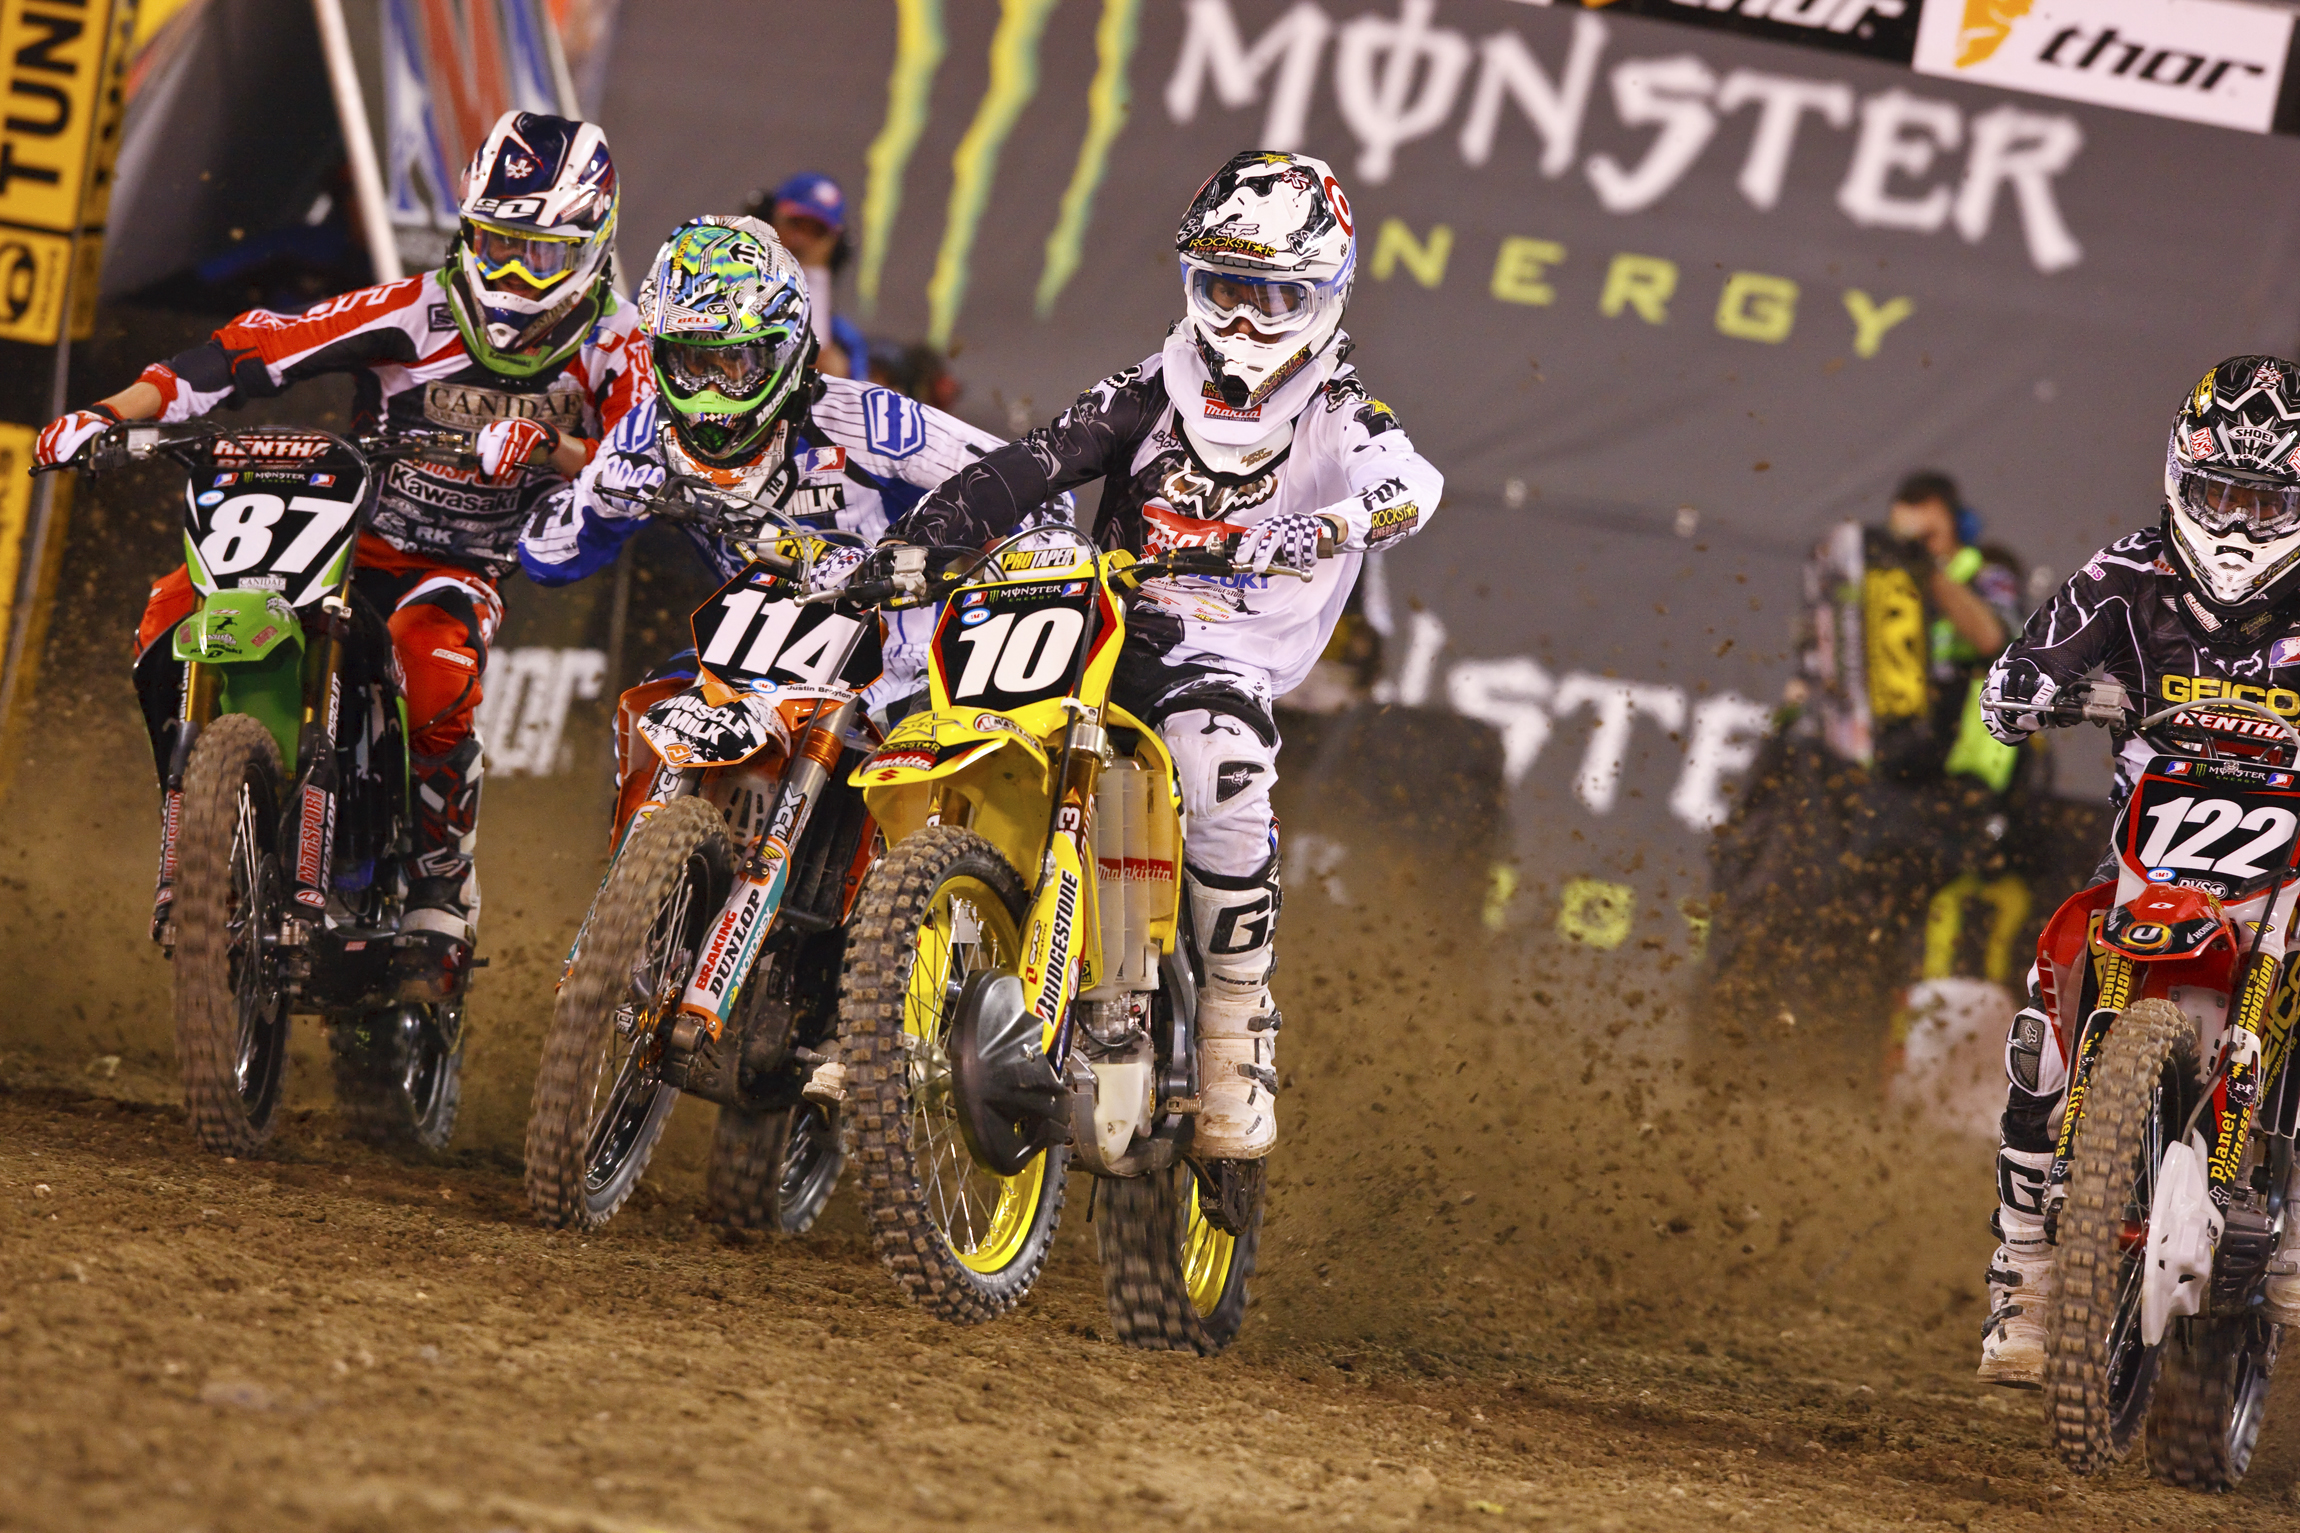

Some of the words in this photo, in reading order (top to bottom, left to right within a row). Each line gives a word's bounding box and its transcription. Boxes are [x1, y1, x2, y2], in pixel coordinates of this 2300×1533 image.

[2036, 24, 2267, 95] thor
[0, 0, 87, 196] TUN
[1193, 245, 1231, 253] ENERGY
[1236, 248, 1267, 260] DRINK
[1370, 217, 1914, 360] NERGY
[677, 316, 712, 324] BELL
[430, 387, 582, 420] CANIDAE
[213, 438, 332, 459] RENTHA
[2235, 429, 2274, 443] SHOEI
[255, 470, 307, 482] MONSTER
[389, 462, 521, 514] Kawasaki
[766, 477, 785, 497] 114
[1362, 477, 1409, 512] FOX
[198, 492, 354, 576] 87
[415, 525, 453, 545] RK
[1371, 523, 1399, 539] ENERGY
[239, 577, 286, 588] CANIDAE
[1001, 584, 1062, 598] MONSTER
[1008, 595, 1052, 603] ENERGY
[701, 588, 852, 692] 114
[954, 607, 1086, 700] 10
[786, 683, 816, 693] Justin
[817, 686, 853, 700] Brayton
[2160, 673, 2300, 717] GEICO
[660, 694, 750, 740] MUSCLE
[661, 708, 727, 746] MILK
[2172, 710, 2298, 741] RENTHA
[2215, 774, 2257, 785] ENERGY
[2138, 796, 2298, 879] 122
[694, 909, 738, 991] BRAKING
[708, 888, 760, 1000] DUNLOP
[735, 903, 775, 986] MOTOREX
[1034, 869, 1079, 1029] BRIDGESTONE
[1037, 922, 1048, 966] industries
[2194, 921, 2217, 938] HONDA
[2054, 1085, 2085, 1158] fitness
[2207, 1109, 2238, 1185] planet
[2224, 1106, 2252, 1182] fitness
